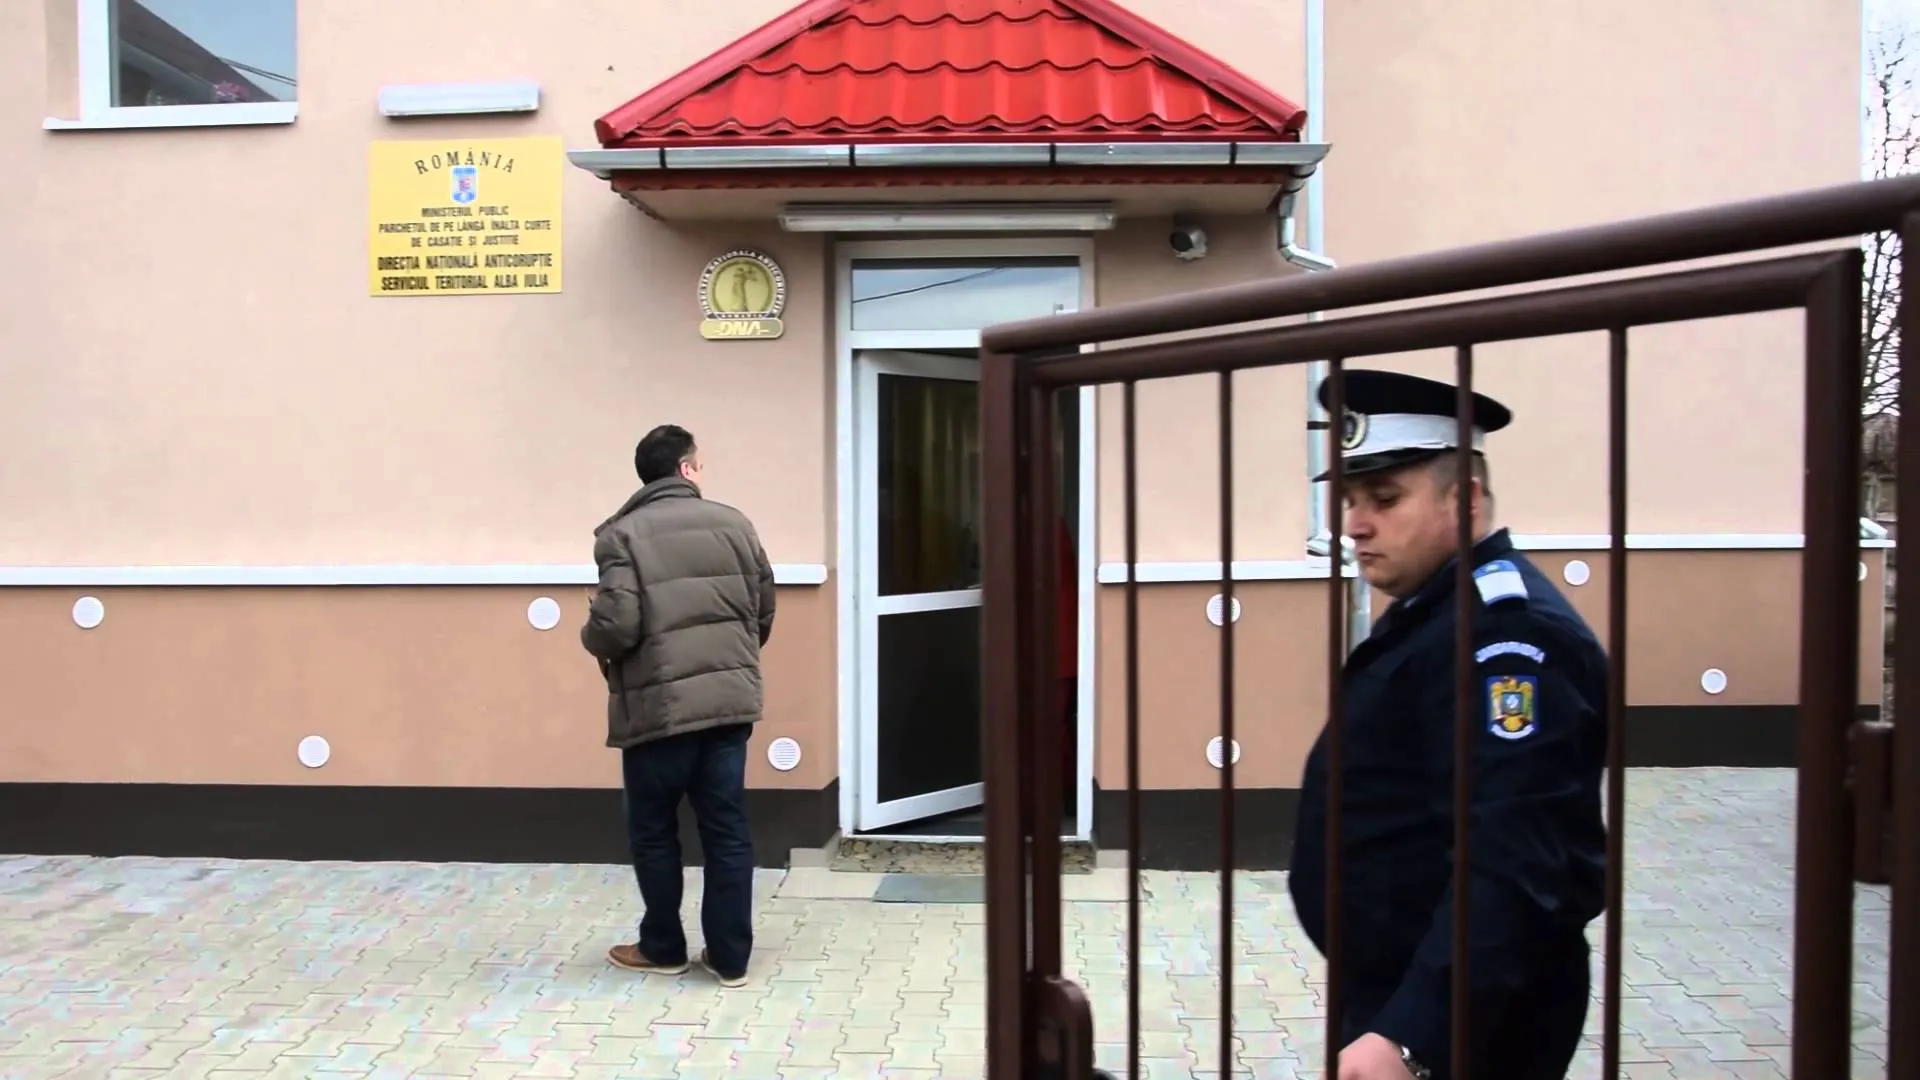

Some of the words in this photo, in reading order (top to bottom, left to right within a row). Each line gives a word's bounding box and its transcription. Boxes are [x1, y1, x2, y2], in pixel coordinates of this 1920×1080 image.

[479, 205, 509, 216] PUBLIC
[430, 222, 441, 232] DE
[443, 222, 455, 232] PE
[524, 219, 552, 231] CURTE
[410, 237, 422, 248] DE
[381, 276, 430, 291] SERVICIUL
[435, 275, 489, 290] TERITORIAL
[493, 273, 519, 288] ALBA
[524, 273, 549, 288] IULIA
[716, 321, 762, 336] DNA
